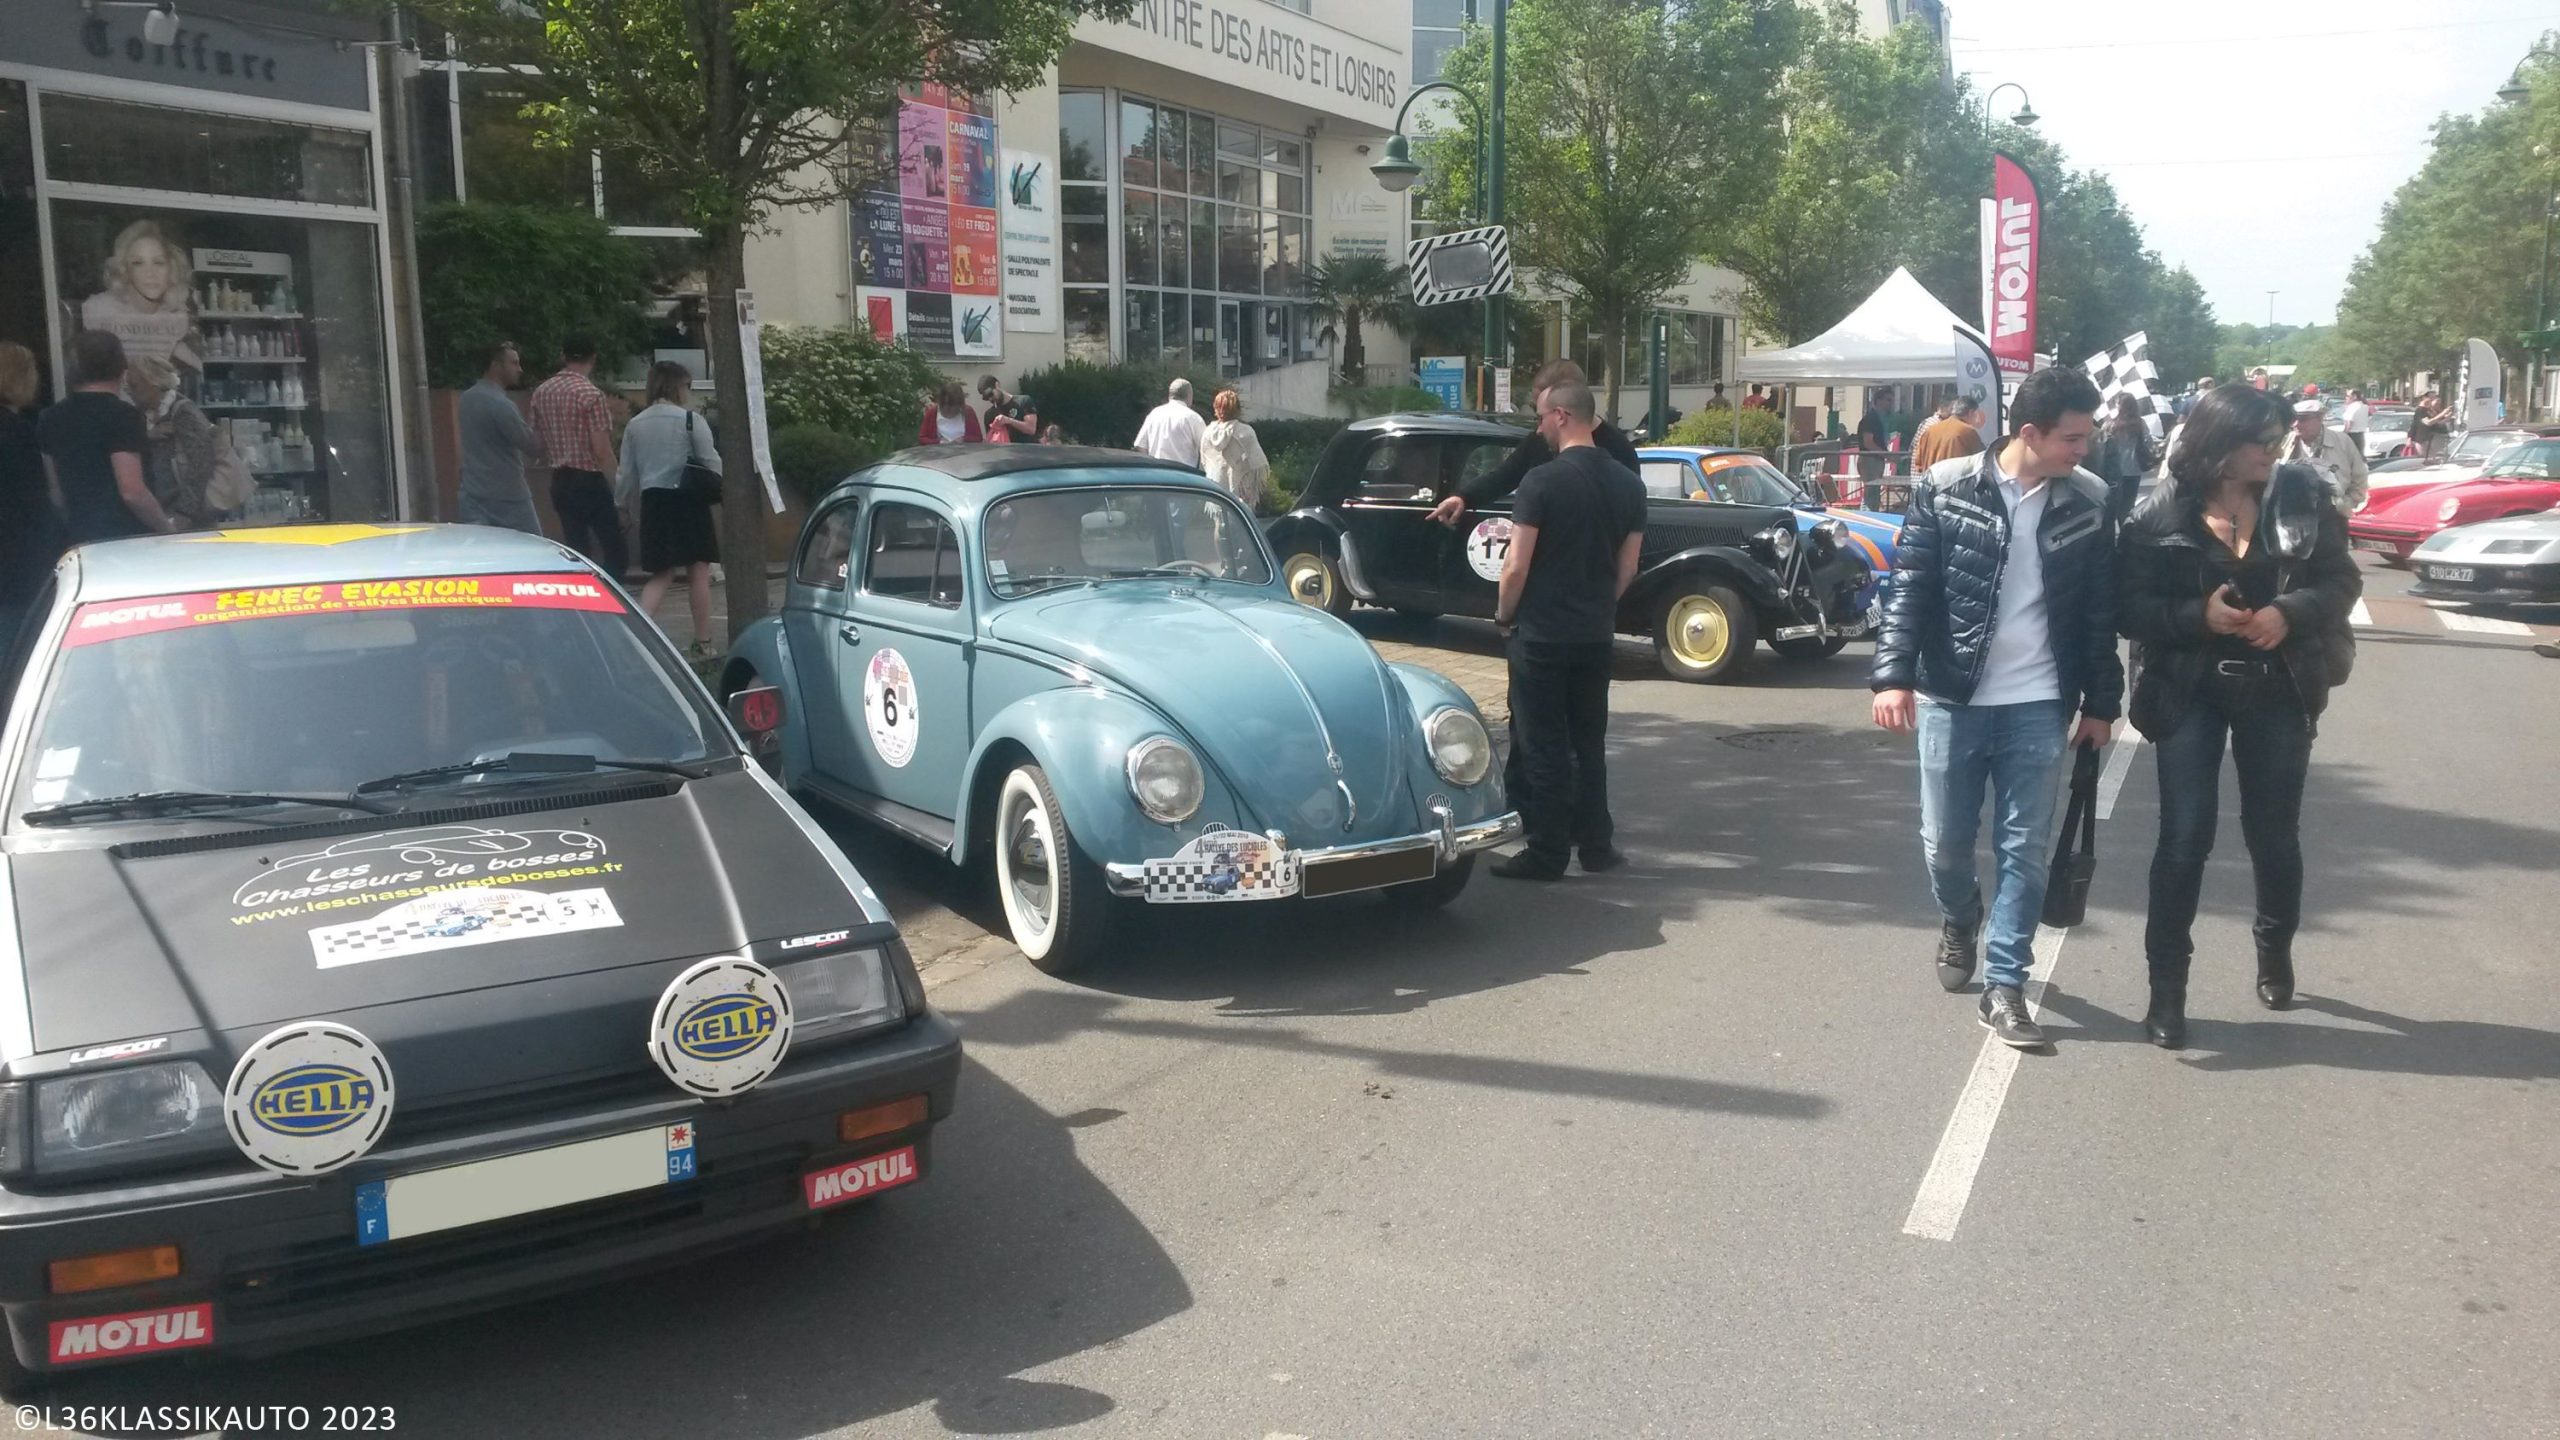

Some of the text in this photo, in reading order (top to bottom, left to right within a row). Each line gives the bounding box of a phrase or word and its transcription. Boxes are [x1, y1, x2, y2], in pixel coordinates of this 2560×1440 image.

[80, 17, 277, 82] Coiffure
[1128, 0, 1396, 109] NTRE DES ARTS ET LOISIRS
[949, 120, 989, 140] CARNAVAL
[880, 219, 897, 232] LUNE
[912, 224, 943, 238] GOGUETTE
[974, 220, 990, 231] FRED
[1481, 537, 1511, 560] 17
[2461, 568, 2473, 580] 77
[215, 580, 479, 611] FENEC EVASION
[512, 582, 600, 597] MOTUL
[80, 602, 187, 628] MOTUL
[193, 593, 512, 622] Organisation de rallyes Historiques
[883, 687, 898, 727] 6
[1194, 838, 1204, 858] 4
[1205, 843, 1225, 853] RALLYE
[1227, 843, 1238, 852] DES
[1240, 841, 1267, 851] LUCIOLES
[241, 850, 594, 908] Chasseurs de bosses
[306, 864, 371, 883] Les
[1284, 867, 1291, 882] 6
[230, 862, 623, 926] www.leschasseursdebosses.fr
[563, 905, 575, 917] 5
[780, 930, 850, 949] LESCOT
[681, 1004, 776, 1042] HELLA
[69, 1037, 168, 1063] LESCOT
[259, 1079, 374, 1115] HELLA
[669, 1154, 693, 1176] 94
[814, 1152, 912, 1203] MOTUL
[366, 1219, 377, 1234] F
[57, 1311, 205, 1357] MOTUL
